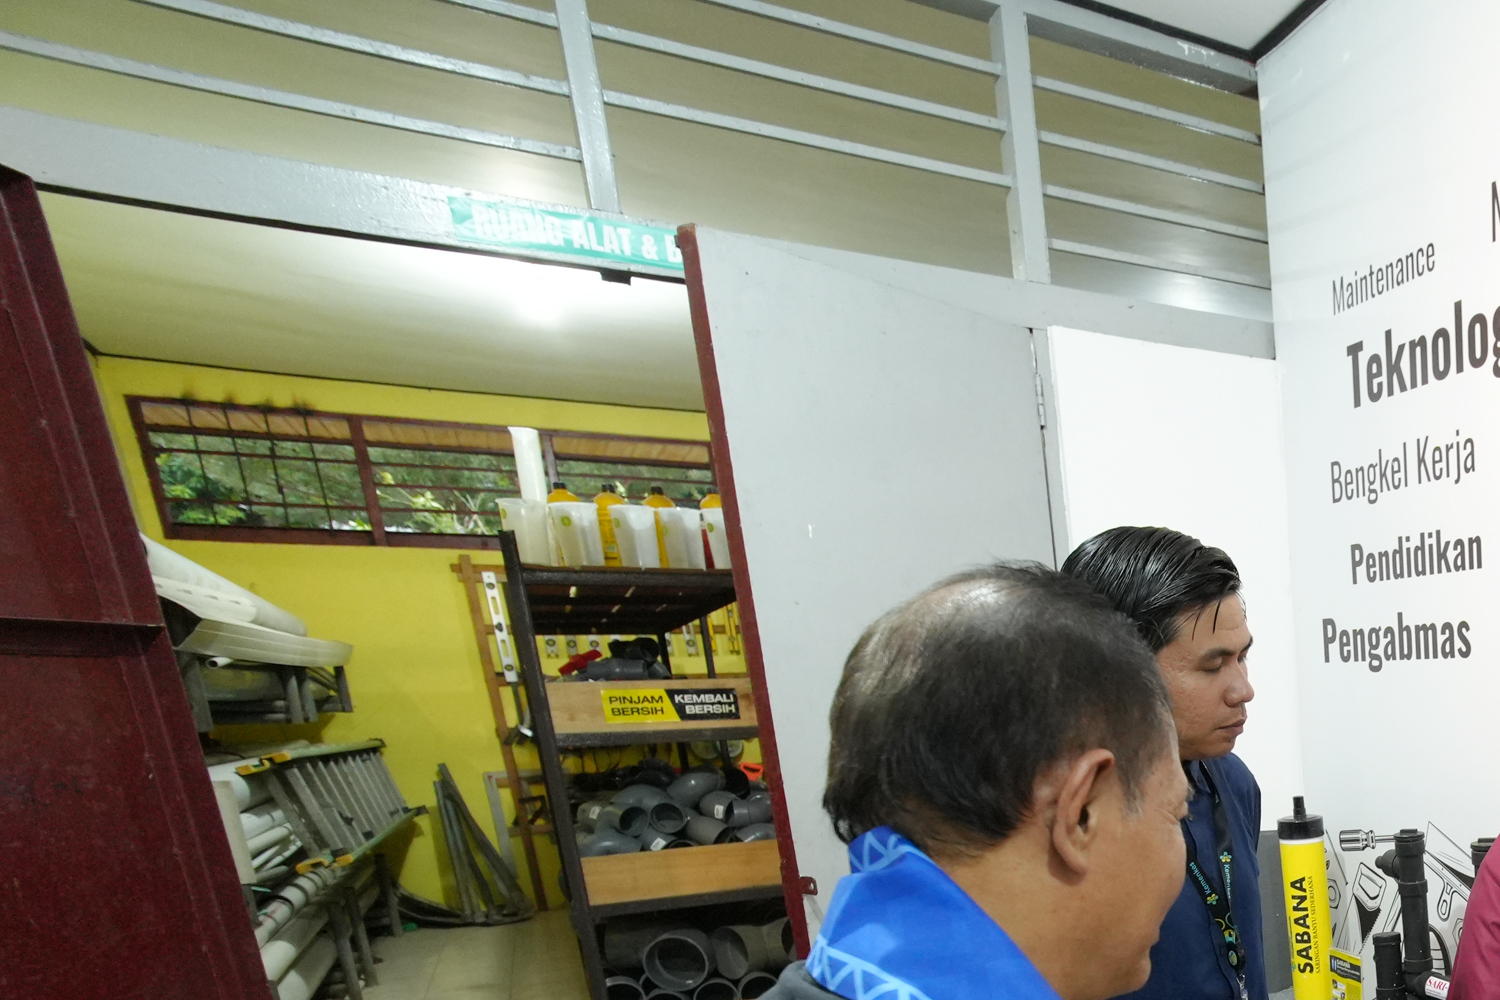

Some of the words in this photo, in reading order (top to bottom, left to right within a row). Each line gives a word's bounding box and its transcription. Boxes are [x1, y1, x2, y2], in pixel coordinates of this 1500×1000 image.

[470, 204, 564, 247] RUANG
[572, 219, 632, 257] ALAT
[641, 234, 659, 260] &
[665, 235, 683, 264] B
[1332, 242, 1435, 316] Maintenance
[1330, 442, 1409, 505] Bengkel
[1416, 429, 1476, 485] Kerja
[1350, 529, 1483, 586] Pendidikan
[1322, 612, 1472, 673] Pengabmas
[609, 695, 663, 705] PINJAM
[611, 707, 665, 717] BERSIH
[674, 693, 734, 704] KEMBALI
[685, 704, 736, 715] BERSIH
[1189, 861, 1212, 895] Kemenkes
[1308, 875, 1316, 916] SEDERHANA
[1290, 876, 1314, 974] SABANA
[1313, 940, 1321, 974] SARINGAN
